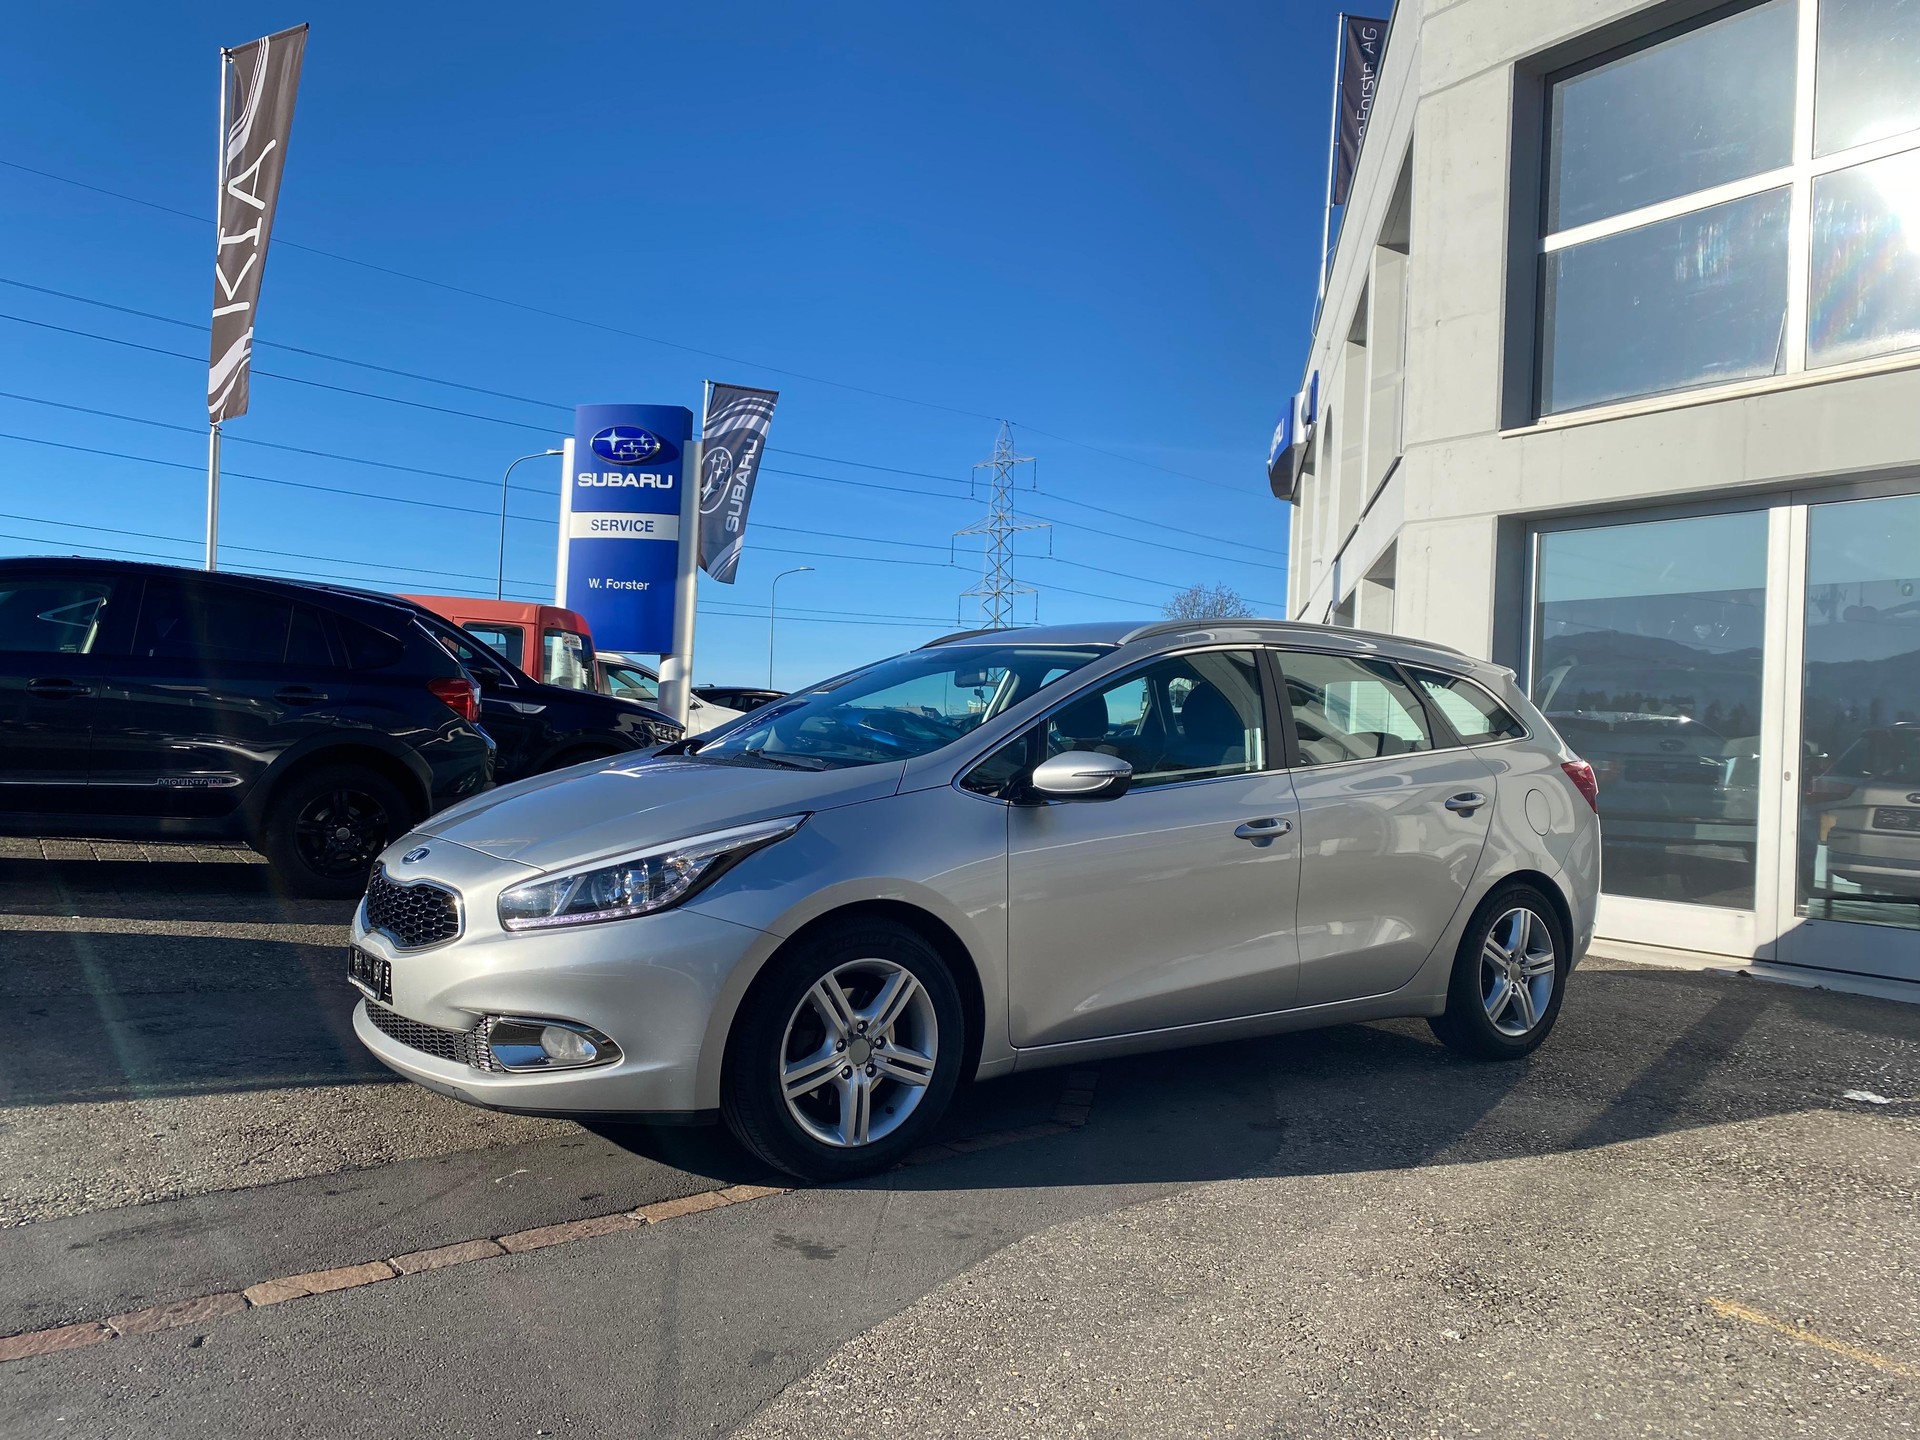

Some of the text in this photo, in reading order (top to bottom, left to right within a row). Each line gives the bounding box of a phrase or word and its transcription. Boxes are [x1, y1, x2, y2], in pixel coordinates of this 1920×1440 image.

[1361, 26, 1378, 54] AG
[1356, 61, 1375, 120] Forste
[211, 138, 277, 318] KIA
[578, 472, 673, 489] SUBARU
[725, 438, 758, 533] SUBARU
[590, 519, 654, 533] SERVICE
[588, 578, 650, 590] W. Forster
[156, 777, 222, 786] MOUNTAIN
